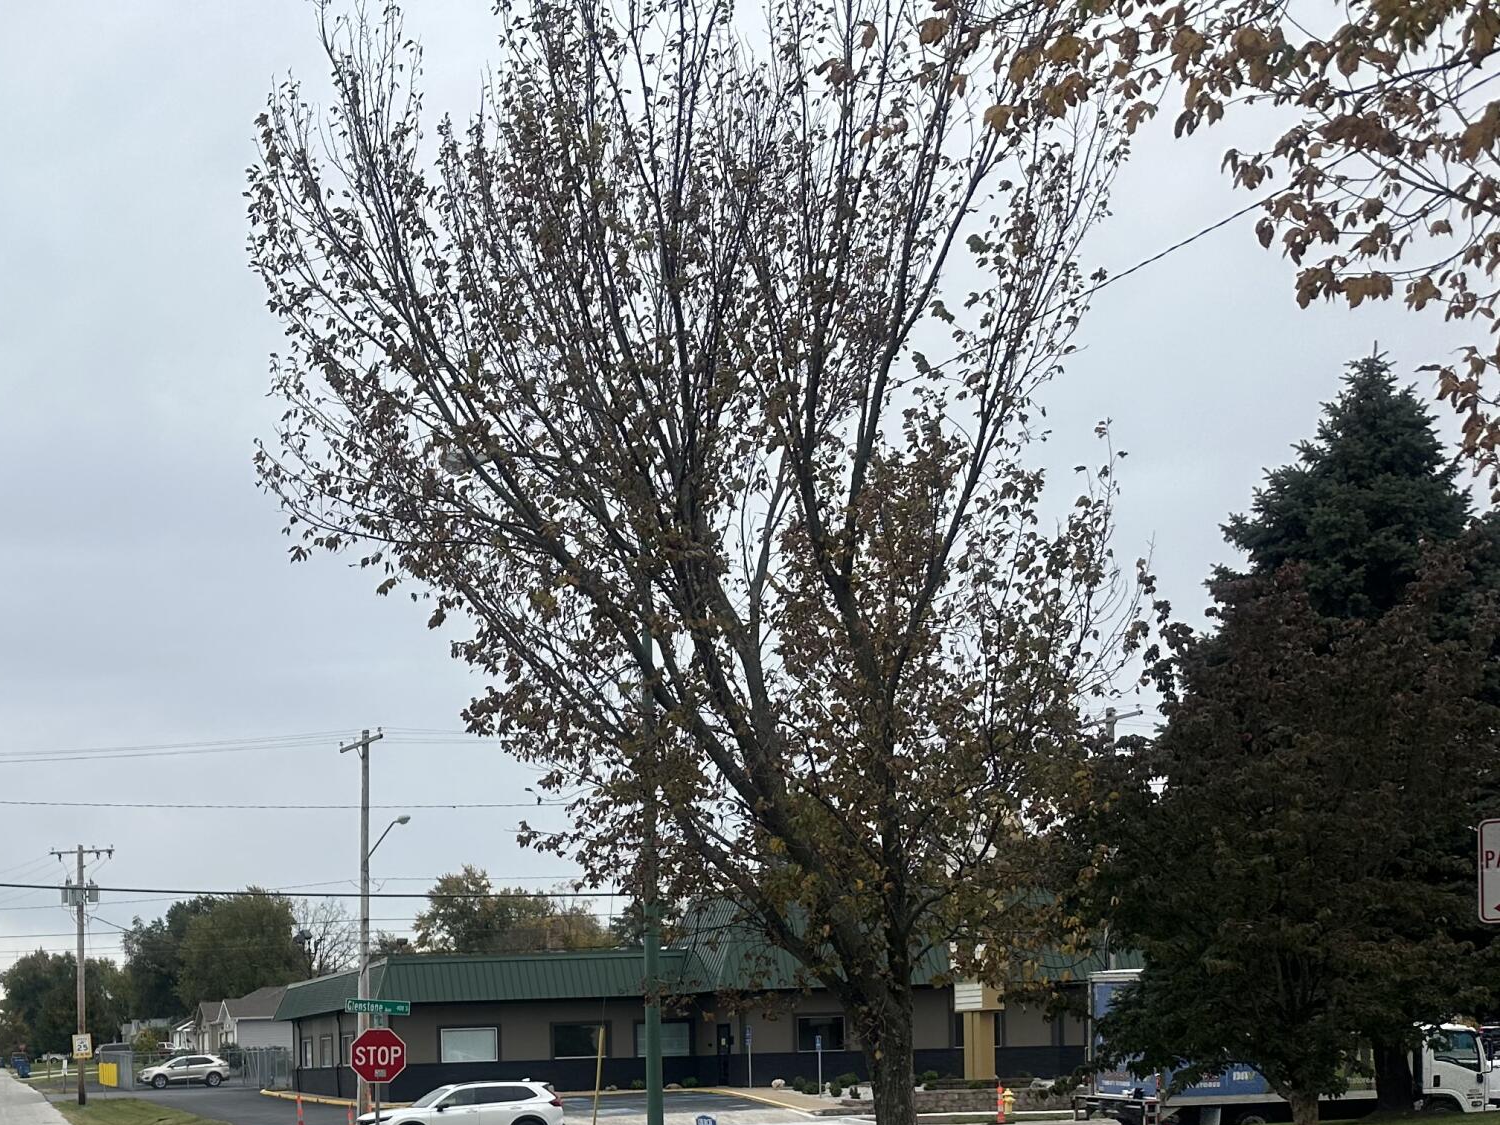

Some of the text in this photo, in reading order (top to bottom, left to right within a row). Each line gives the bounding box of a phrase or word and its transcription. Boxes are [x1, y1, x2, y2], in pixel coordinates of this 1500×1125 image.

[1485, 850, 1500, 869] P
[347, 1000, 384, 1012] Glenstone
[77, 1044, 89, 1052] 25
[354, 1046, 402, 1066] STOP
